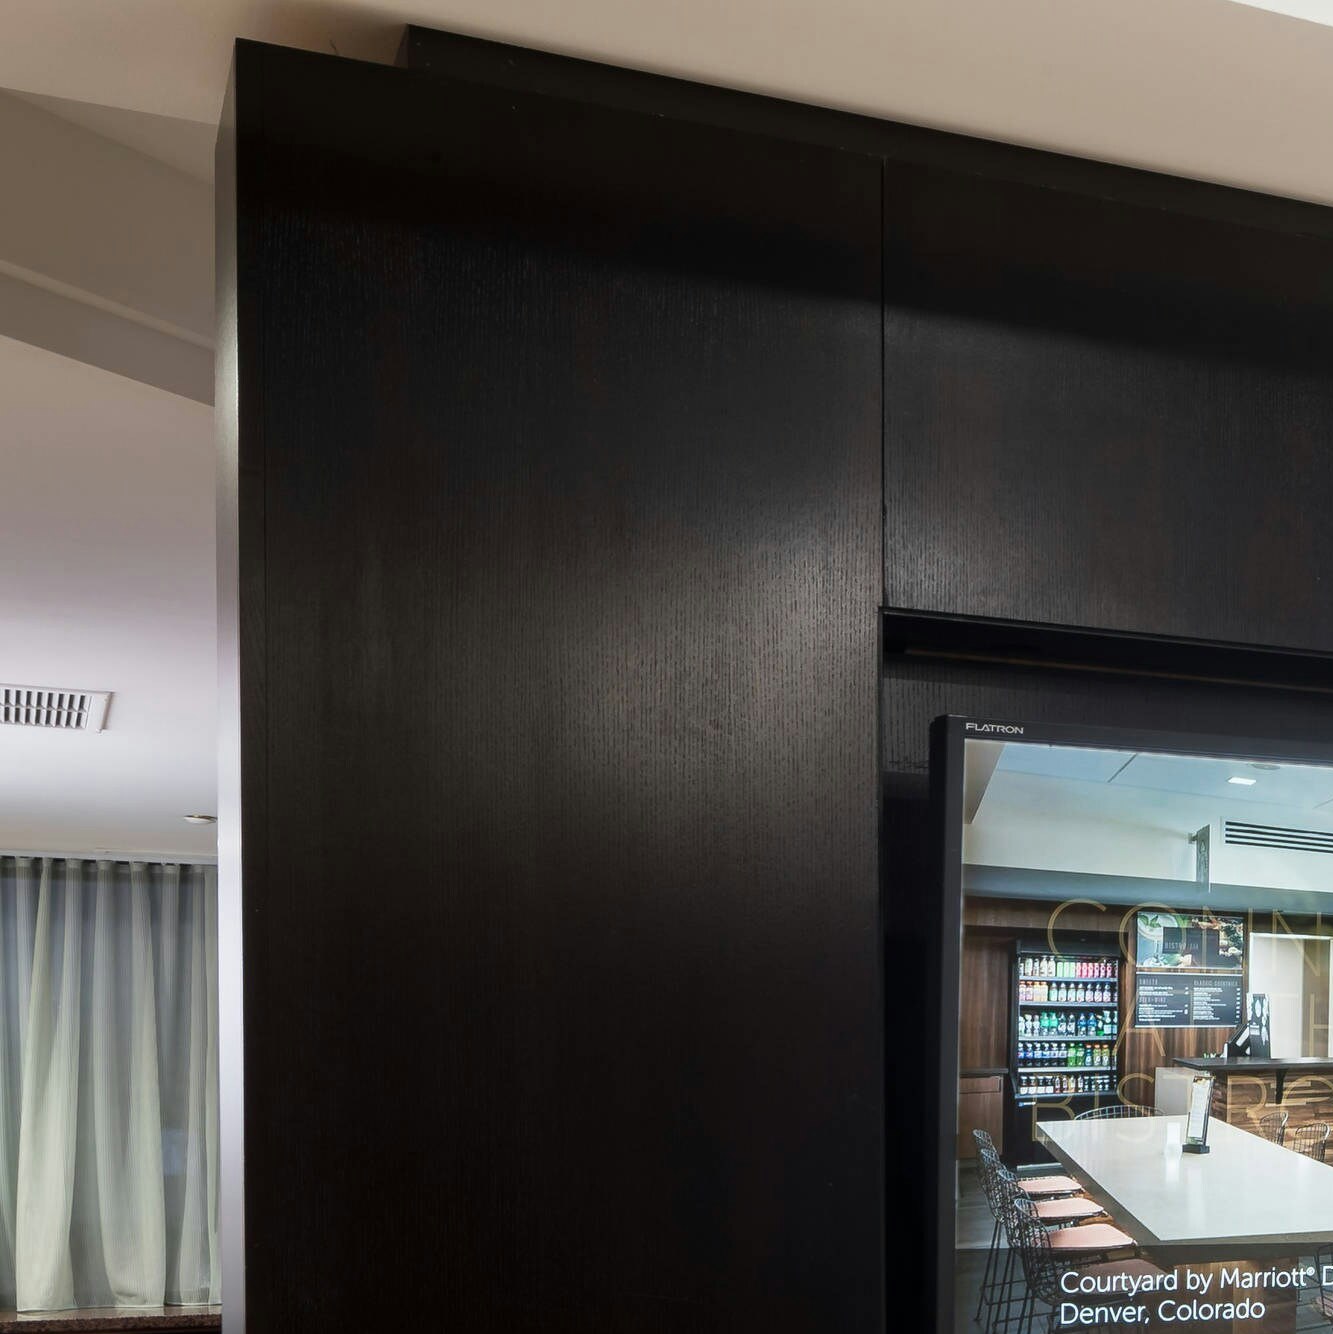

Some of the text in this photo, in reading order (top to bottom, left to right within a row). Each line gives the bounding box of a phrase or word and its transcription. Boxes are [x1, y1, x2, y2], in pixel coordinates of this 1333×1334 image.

[965, 722, 1024, 734] FLATRON
[1059, 1268, 1179, 1297] Courtyard
[1186, 1268, 1214, 1296] by
[1059, 1297, 1267, 1326] Denver, Colorado
